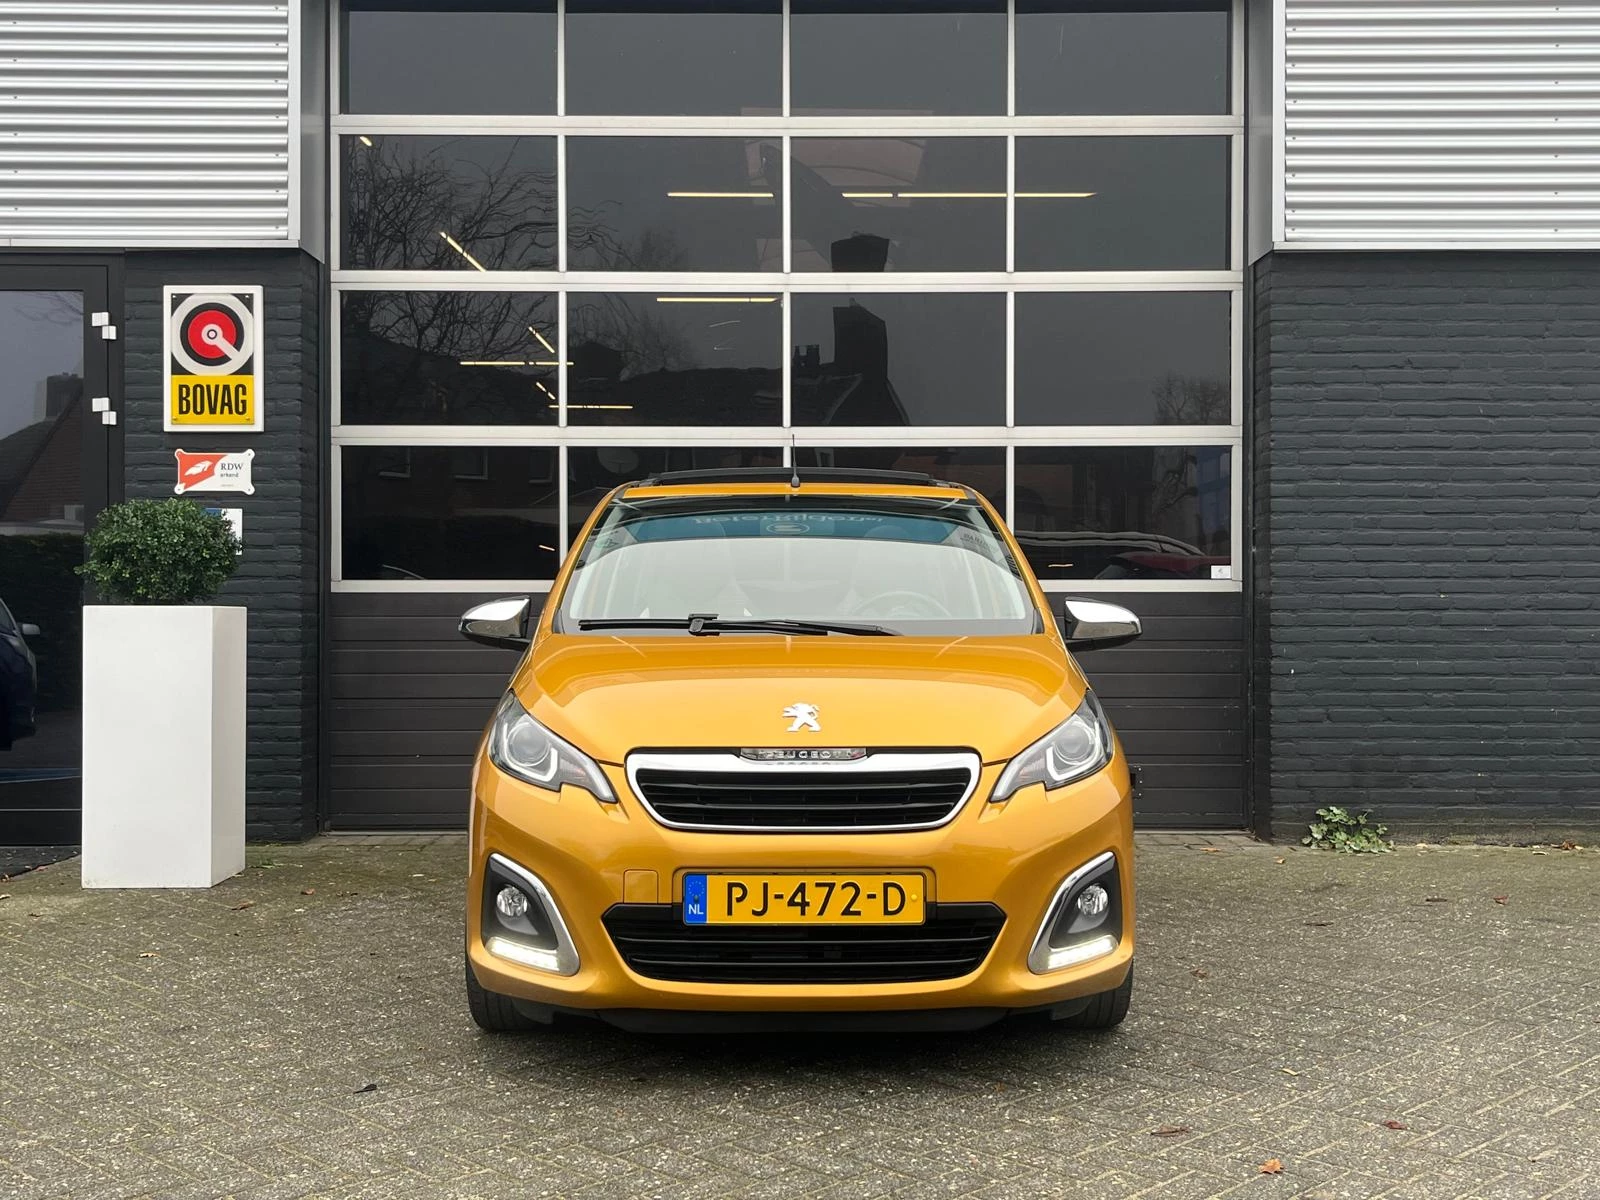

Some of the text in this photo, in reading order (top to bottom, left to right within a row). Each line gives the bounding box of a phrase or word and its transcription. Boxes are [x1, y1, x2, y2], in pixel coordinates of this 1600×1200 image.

[178, 384, 247, 415] BOVAG
[220, 463, 243, 471] RDW
[687, 903, 704, 915] NL
[727, 881, 906, 917] PJ-472-D
